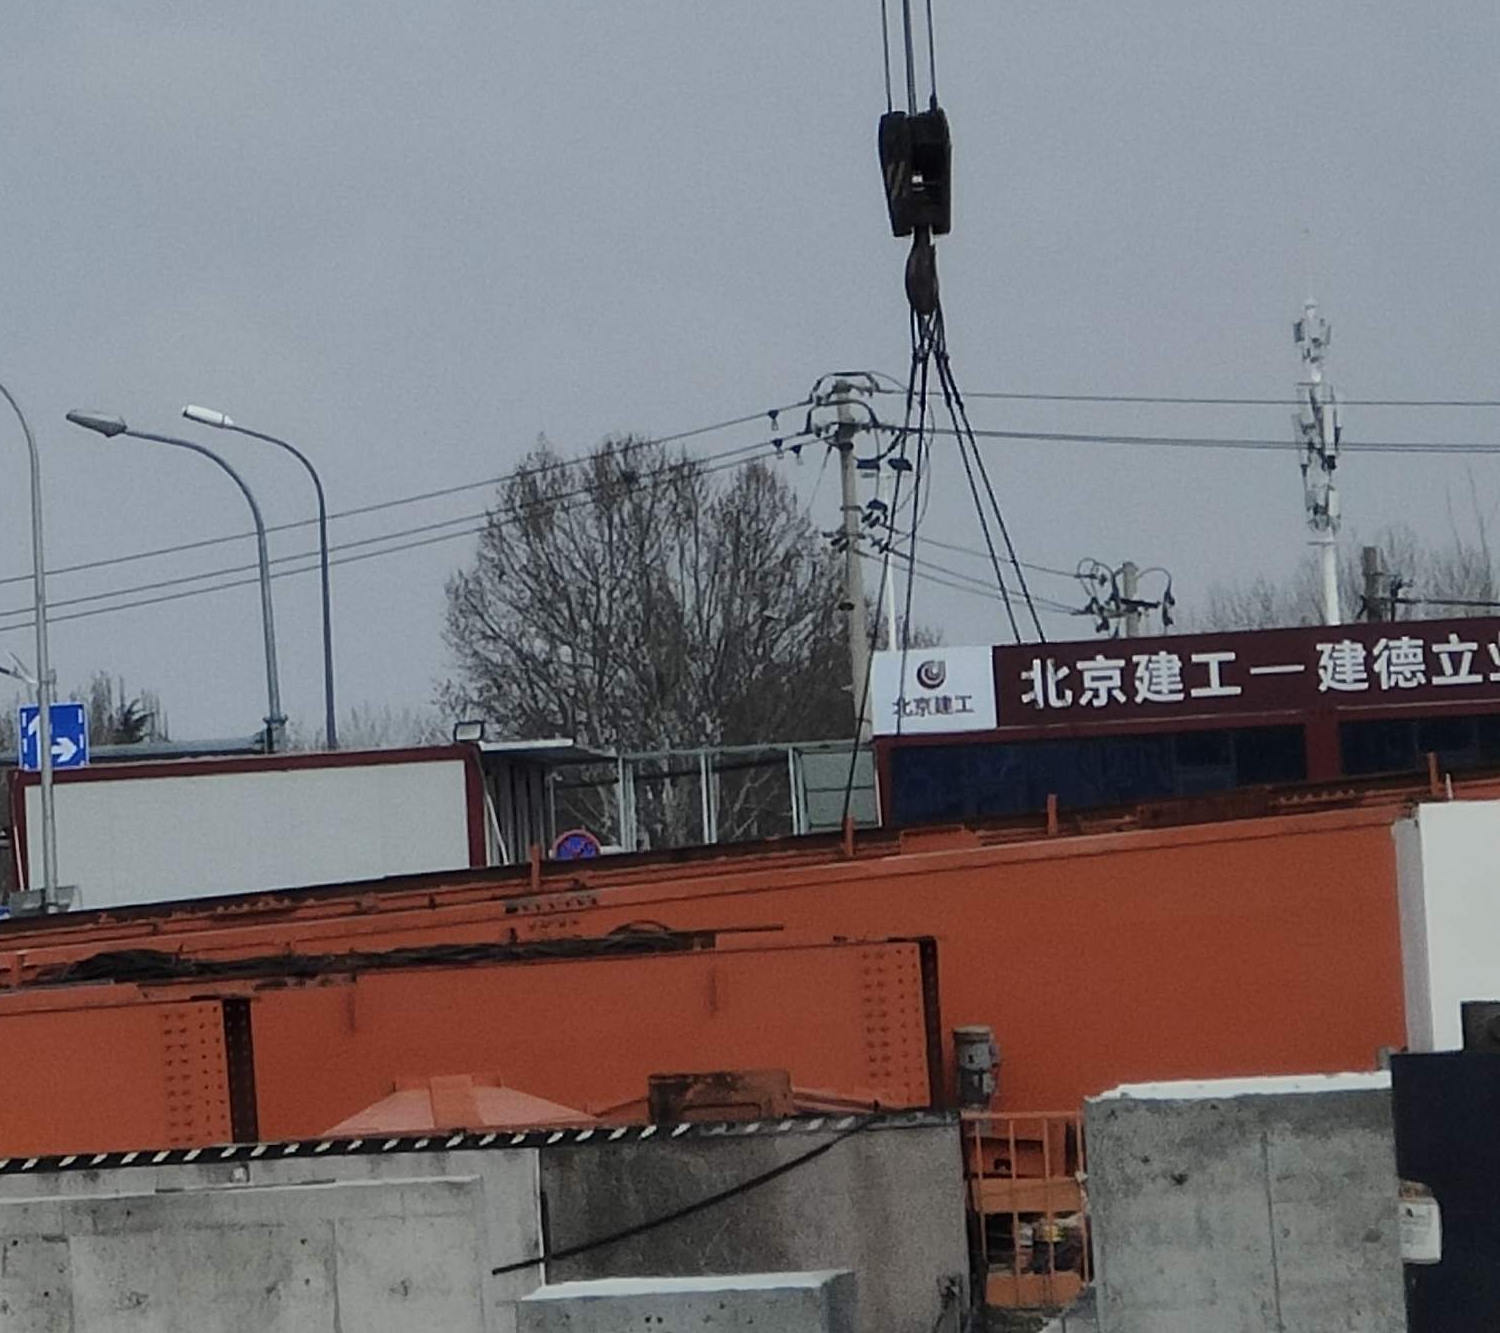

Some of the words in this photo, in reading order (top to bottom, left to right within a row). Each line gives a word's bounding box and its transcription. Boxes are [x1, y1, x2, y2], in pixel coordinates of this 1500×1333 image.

[1020, 631, 1500, 709] 北京建工一建德立
[892, 694, 975, 718] 北京建工
